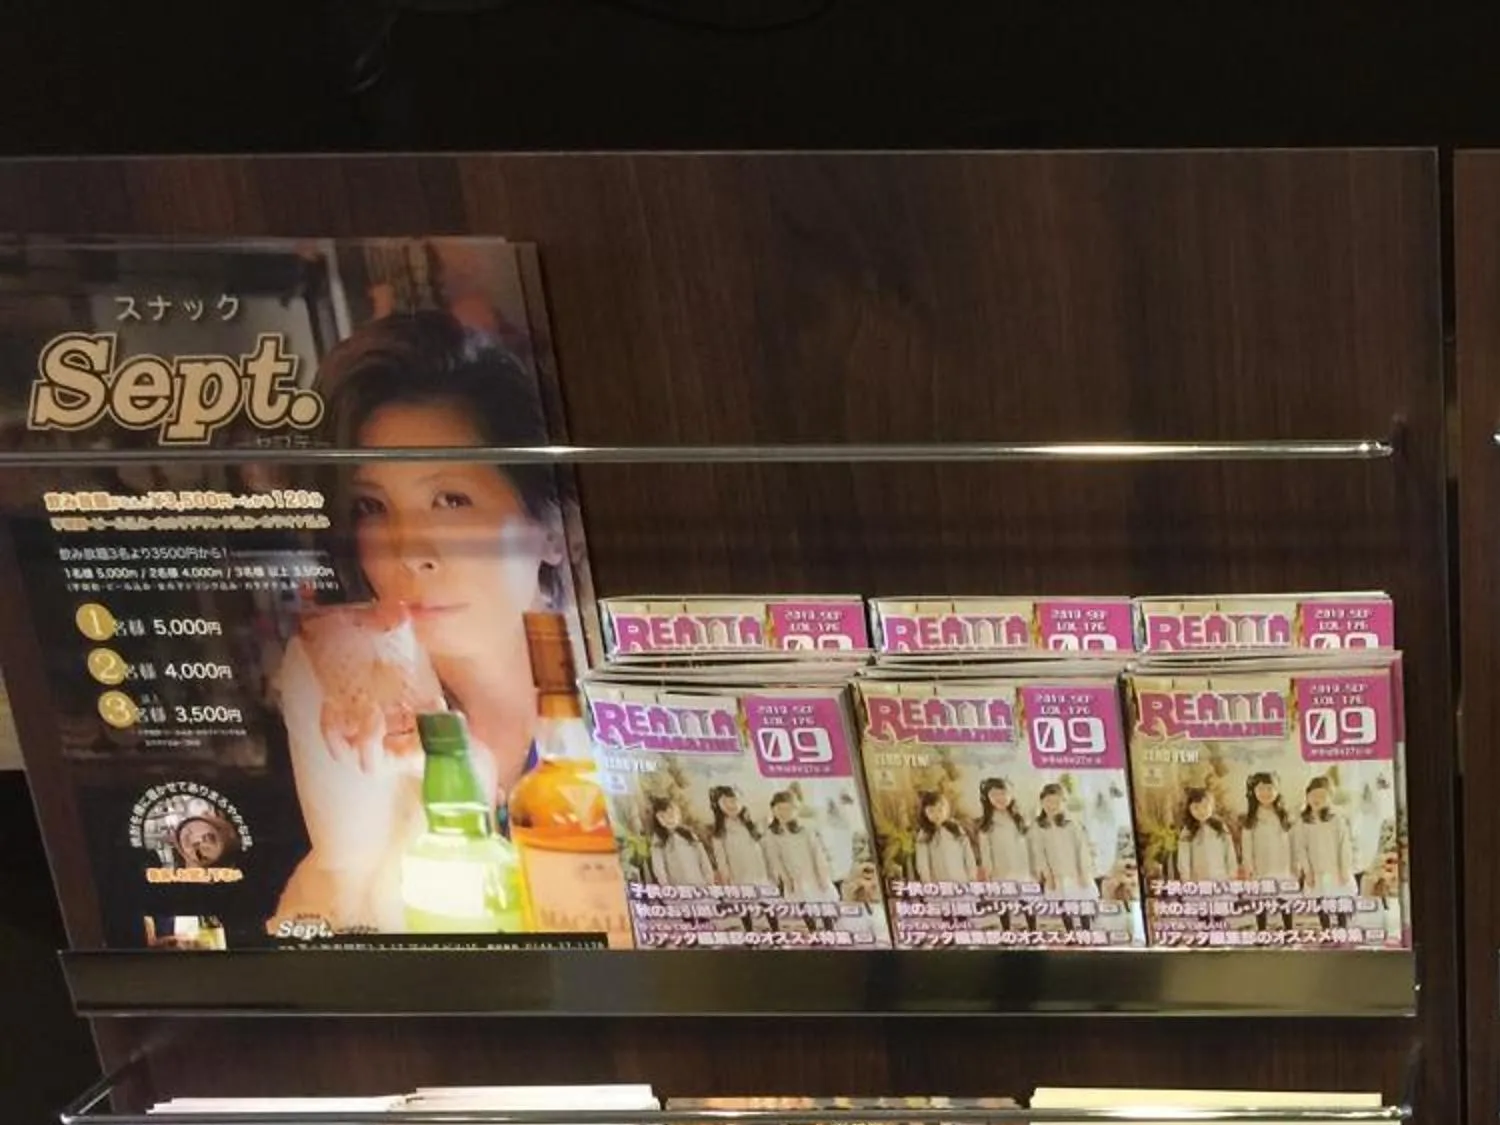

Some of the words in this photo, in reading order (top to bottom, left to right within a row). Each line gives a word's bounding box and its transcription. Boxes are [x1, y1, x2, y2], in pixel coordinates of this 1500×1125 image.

[116, 295, 240, 323] スナック
[28, 333, 324, 444] Sept.
[153, 619, 222, 637] 5,000円
[165, 663, 232, 680] 4,000円
[175, 706, 242, 723] 3,500円
[594, 700, 739, 746] REATTA
[866, 696, 1013, 741] REATTA
[1139, 691, 1286, 735] REATTA
[1306, 707, 1376, 745] 09
[757, 727, 833, 762] 09
[1032, 717, 1106, 754] 09
[276, 919, 334, 939] Sept.
